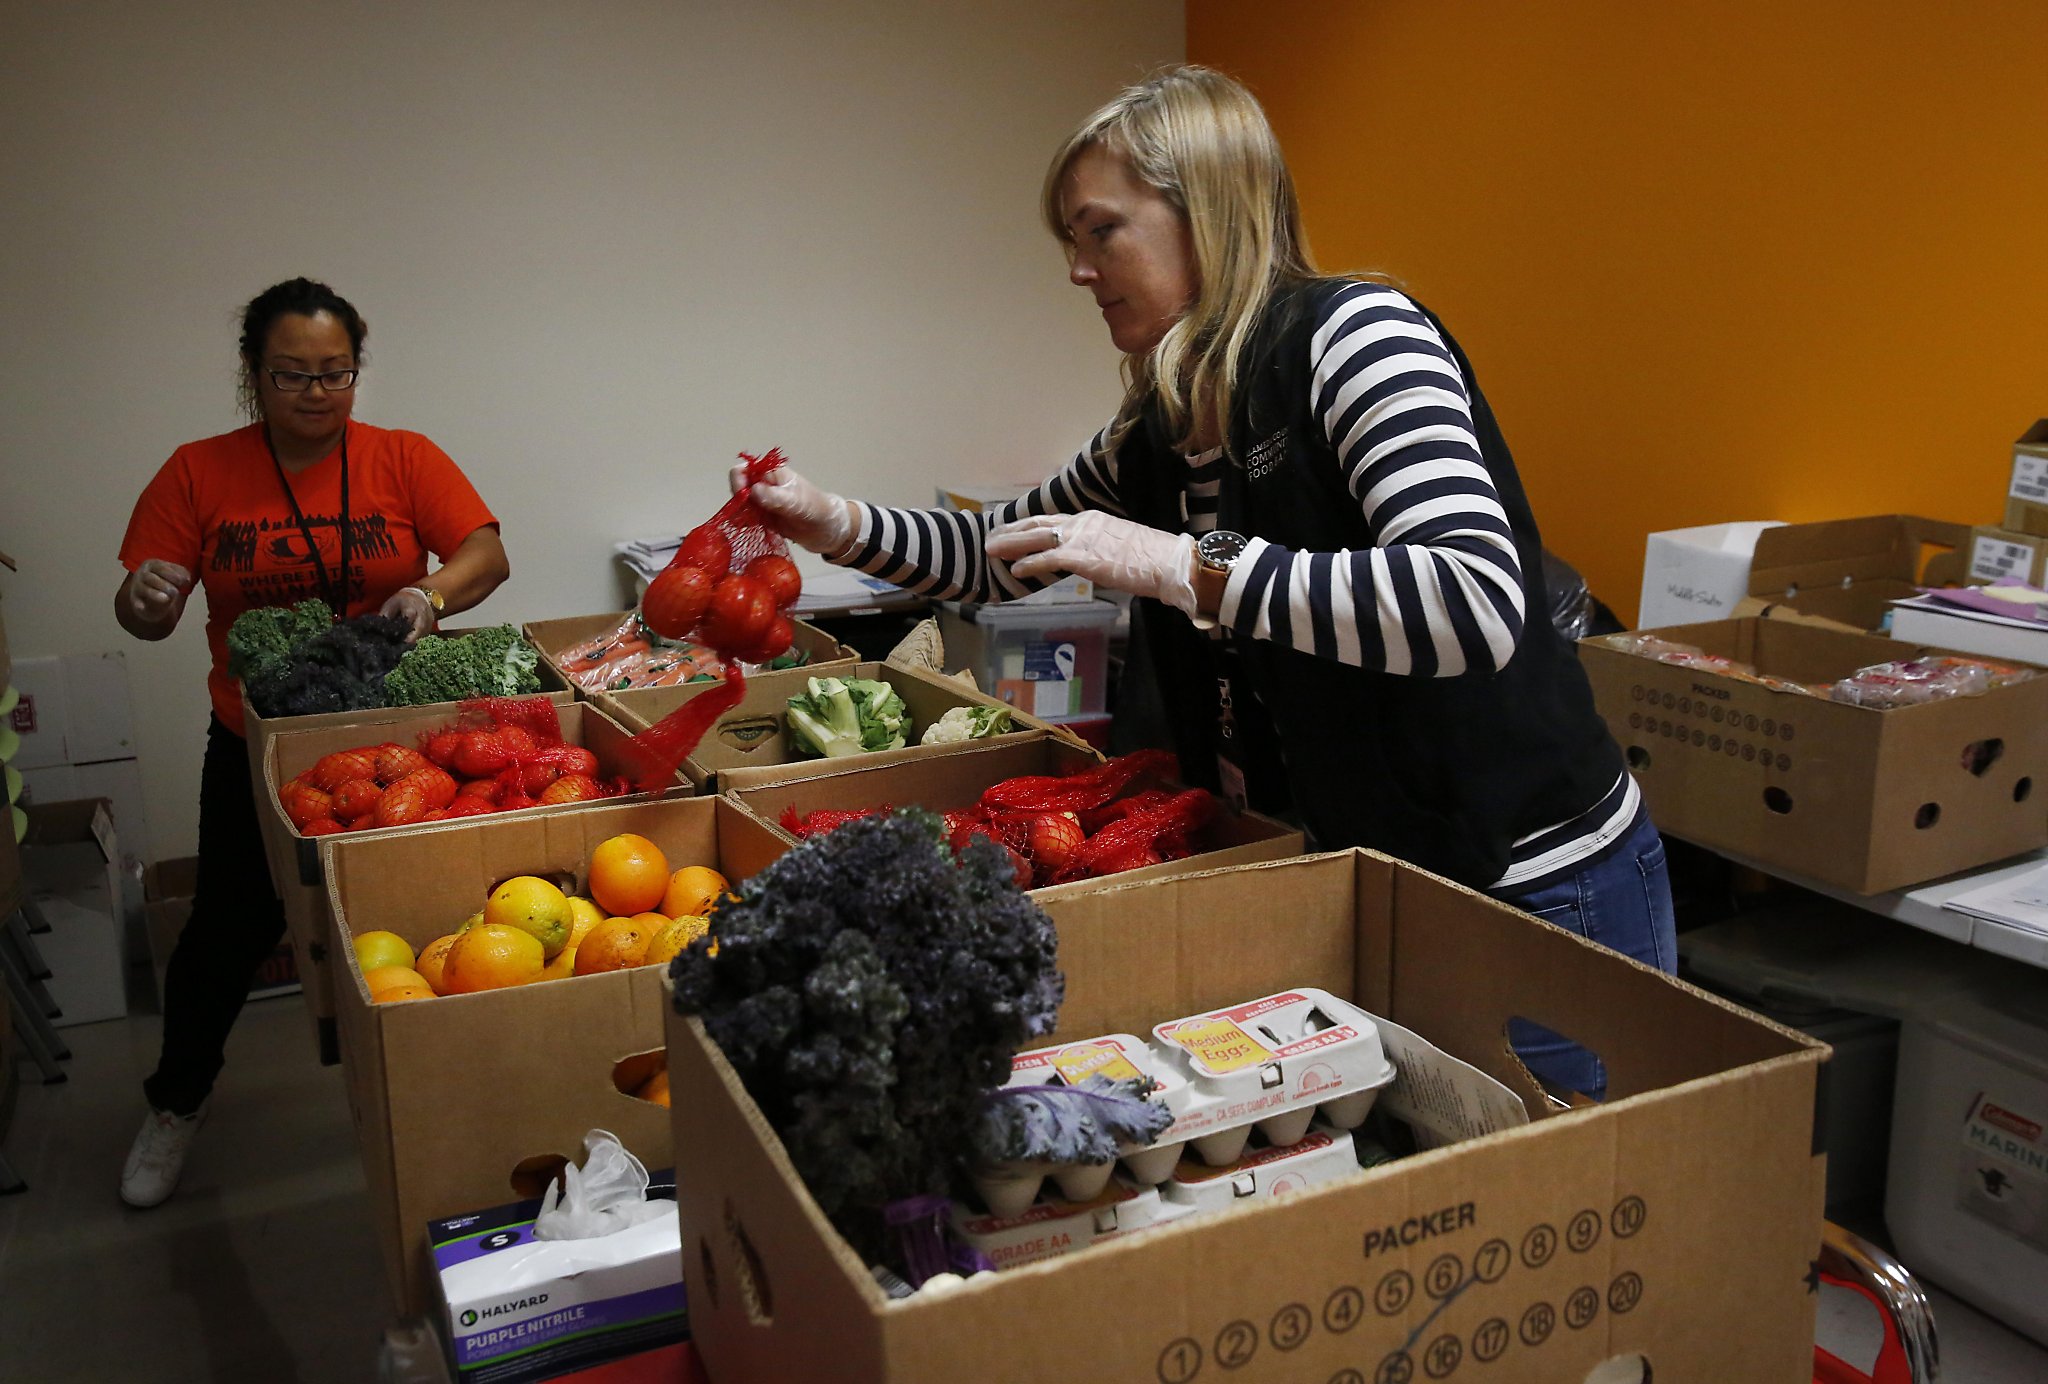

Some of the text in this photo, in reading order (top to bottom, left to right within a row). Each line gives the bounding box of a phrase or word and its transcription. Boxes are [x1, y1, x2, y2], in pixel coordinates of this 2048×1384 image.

[239, 571, 304, 588] WHERE
[1692, 683, 1732, 701] PACKER
[1181, 1030, 1241, 1048] Medium
[1283, 1034, 1342, 1055] GRADE AA
[1202, 1044, 1251, 1061] Eggs
[1970, 1124, 2048, 1174] MARIN
[491, 1234, 509, 1247] S
[1363, 1202, 1476, 1258] PACKER
[991, 1238, 1045, 1264] GRADE
[1050, 1233, 1072, 1249] AA
[482, 1293, 549, 1320] HALYARD
[466, 1307, 586, 1351] PURPLE NITRILE
